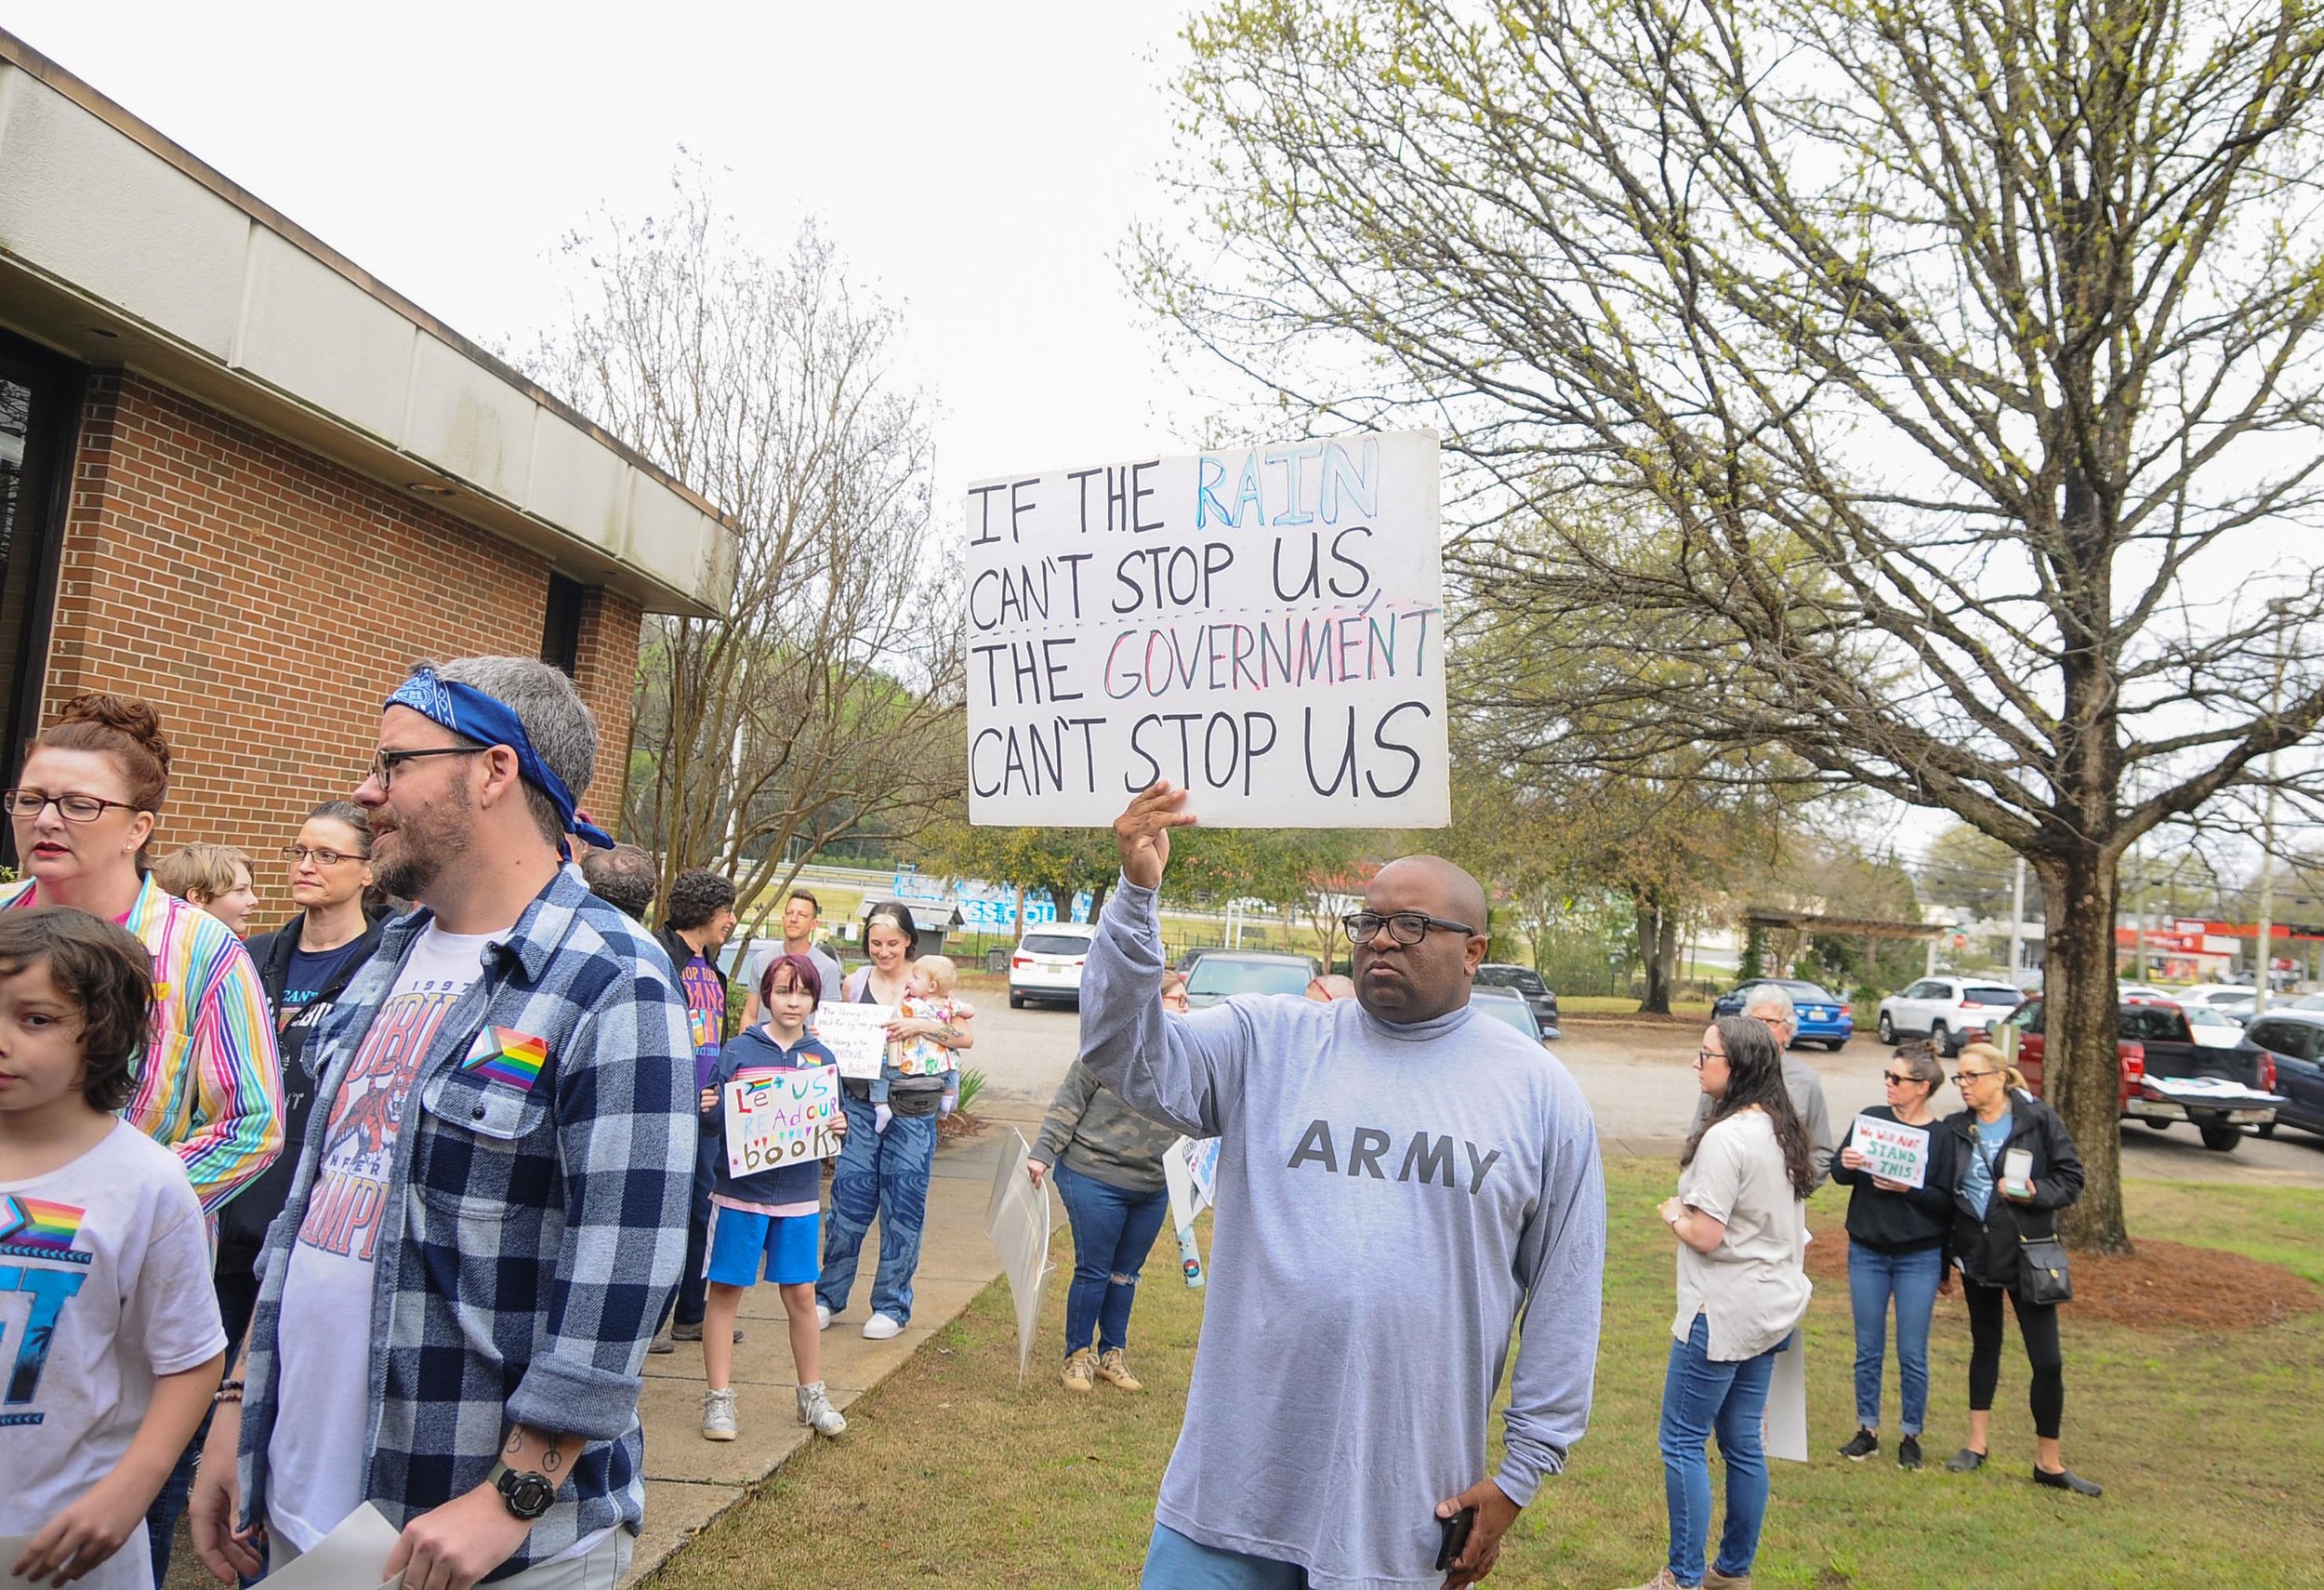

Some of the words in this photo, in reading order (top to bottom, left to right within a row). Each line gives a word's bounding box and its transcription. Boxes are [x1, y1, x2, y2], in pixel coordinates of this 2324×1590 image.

[968, 478, 1041, 547] IF
[1067, 459, 1165, 534] THE
[1196, 436, 1380, 530] RAIN
[970, 554, 1093, 631] CAN'T
[1112, 542, 1235, 614] STOP
[1273, 526, 1381, 616] US,
[971, 638, 1084, 707] THE
[1103, 608, 1442, 699] GOVERNMENT
[971, 715, 1107, 798] CAN'T
[1124, 711, 1278, 797] STOP
[1304, 702, 1432, 798] US
[412, 980, 472, 993] 1997
[792, 1074, 827, 1099] US
[1287, 1119, 1501, 1195] ARMY
[1868, 1140, 1916, 1162] STAND
